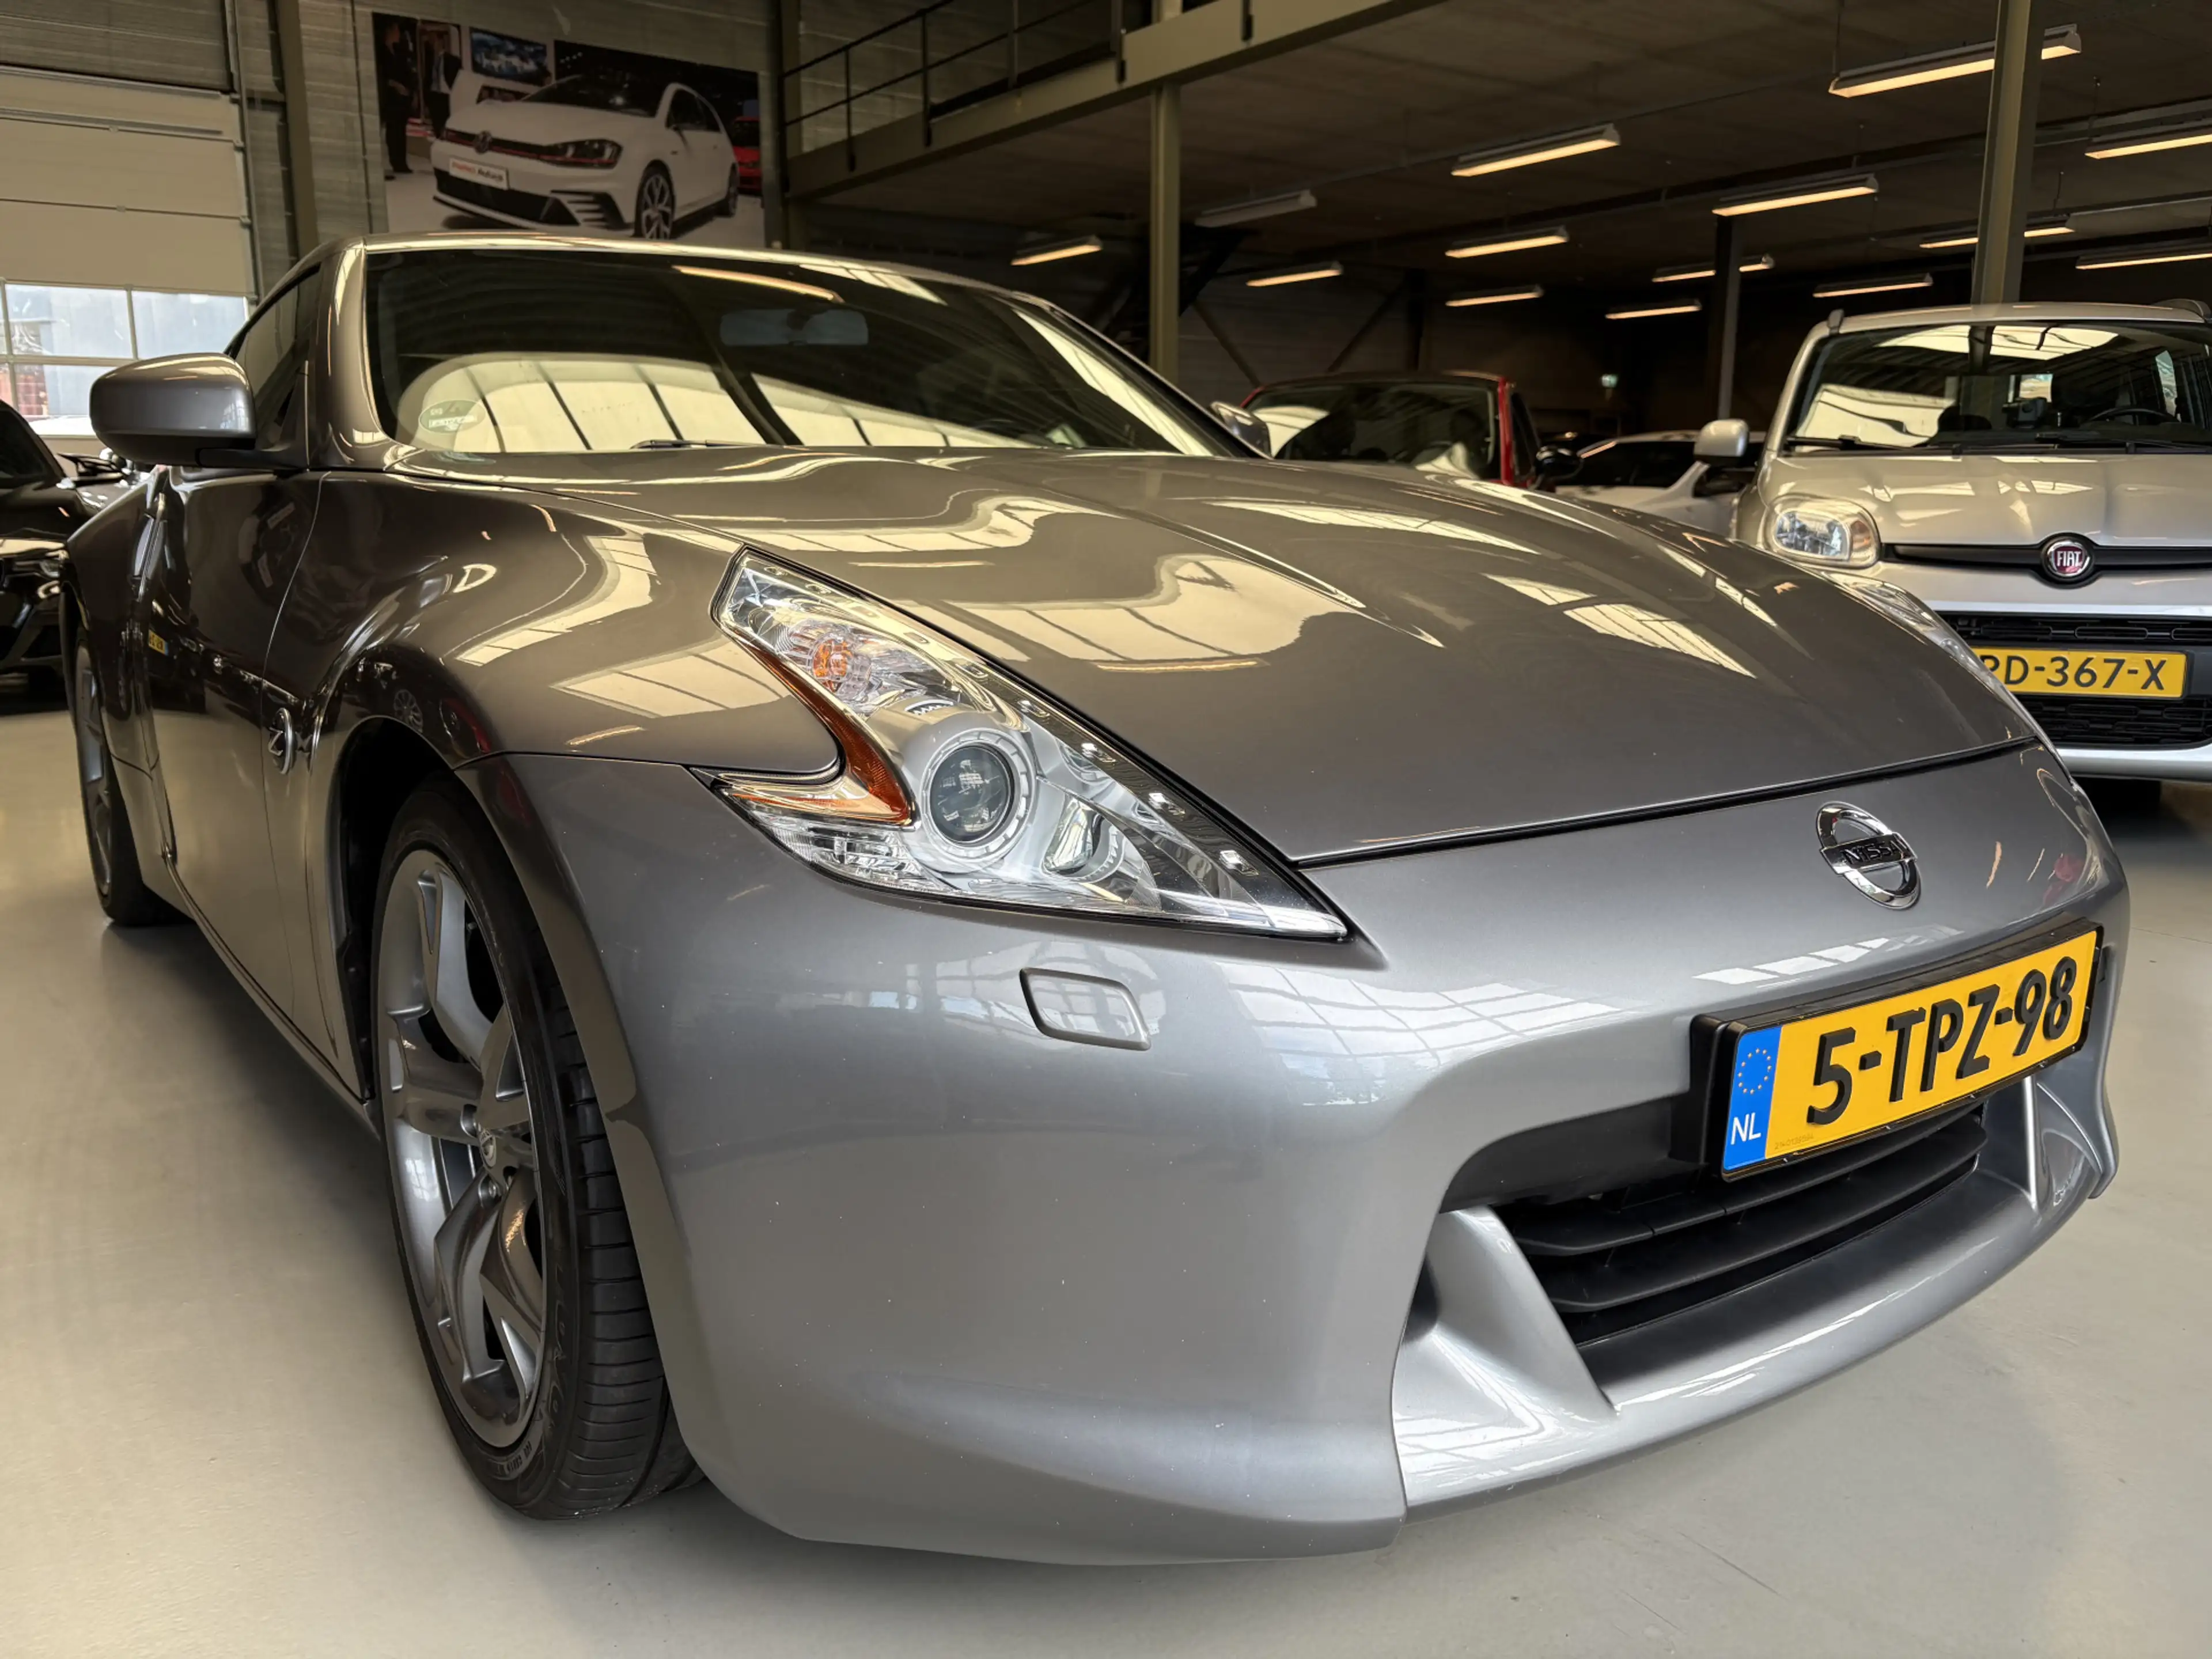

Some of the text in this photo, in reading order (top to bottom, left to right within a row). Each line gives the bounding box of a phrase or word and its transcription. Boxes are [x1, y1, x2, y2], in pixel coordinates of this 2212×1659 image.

[2056, 551, 2082, 567] FIAT
[1806, 956, 2077, 1125] 5-TPZ-98
[1730, 1112, 1762, 1145] NL
